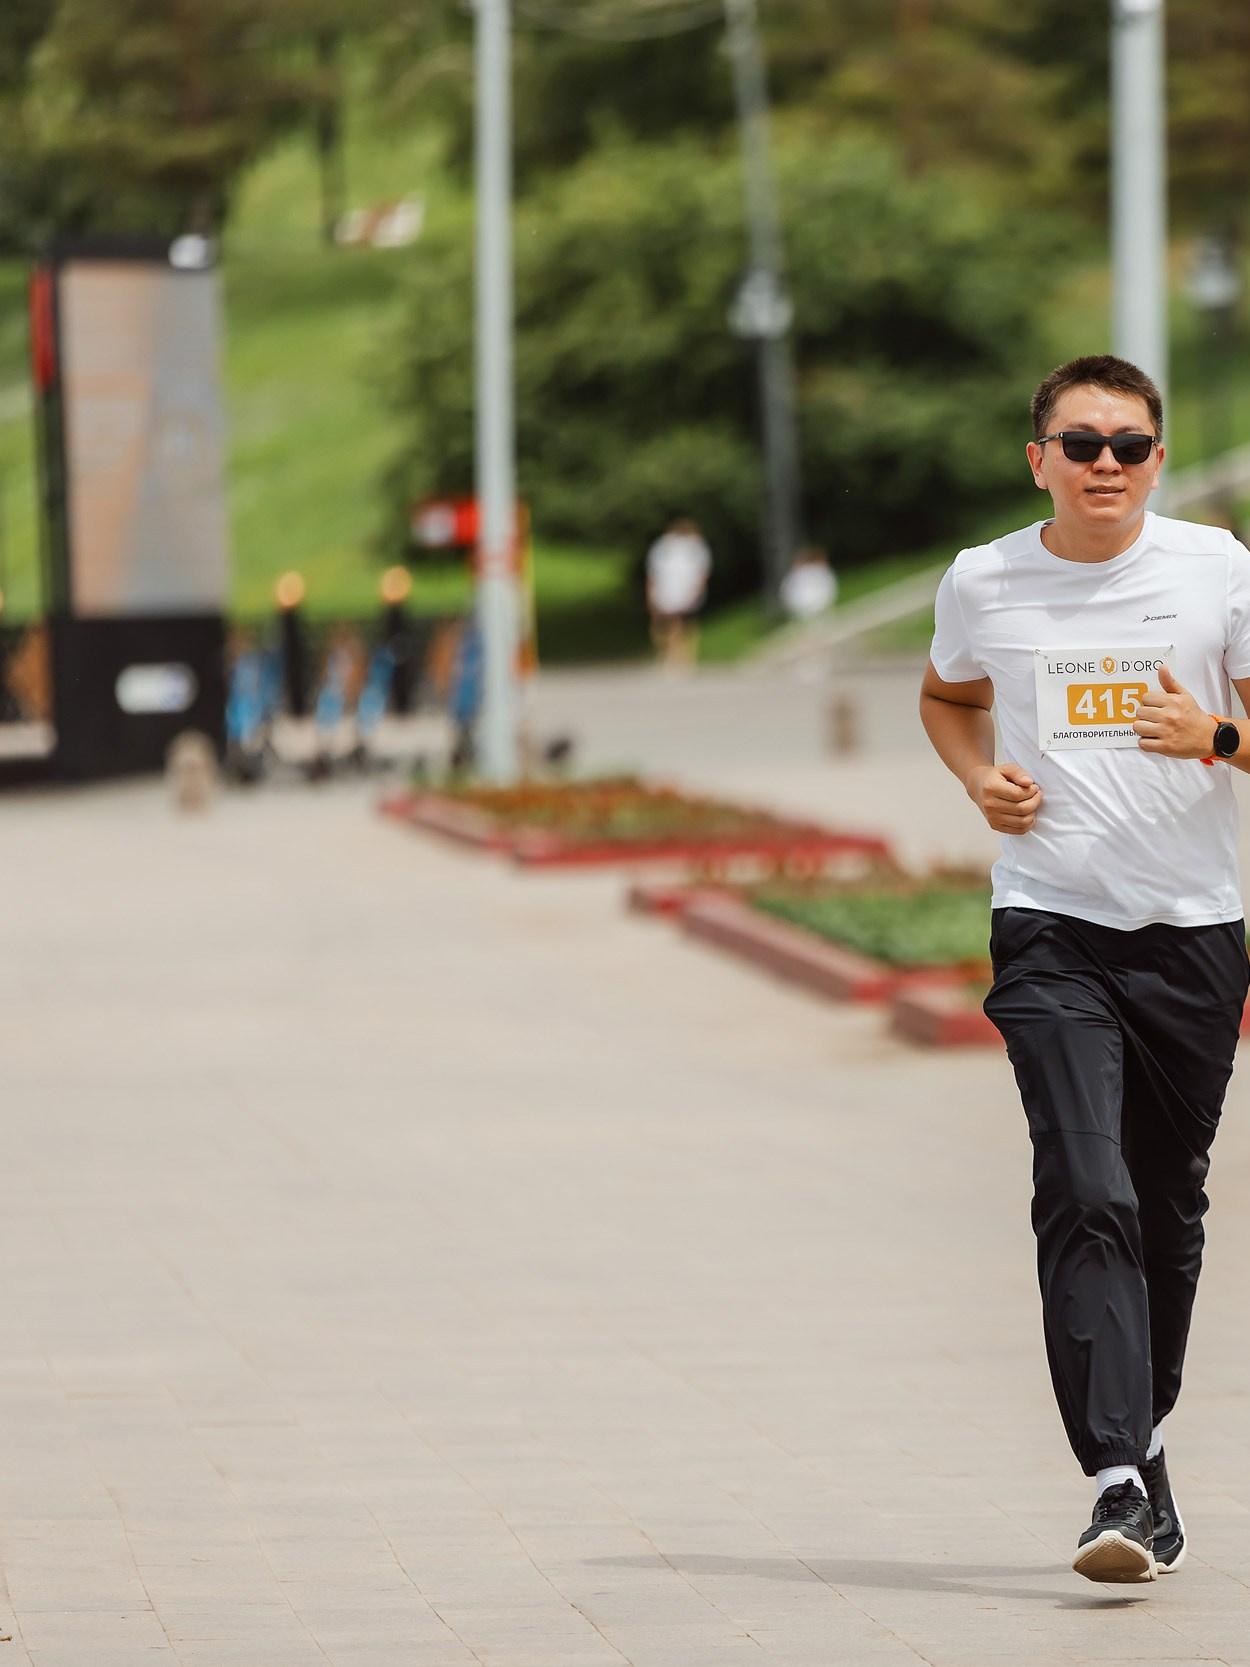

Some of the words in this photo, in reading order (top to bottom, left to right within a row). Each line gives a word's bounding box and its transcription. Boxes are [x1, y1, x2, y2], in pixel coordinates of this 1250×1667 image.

[1048, 661, 1096, 674] LEONE
[1121, 659, 1164, 672] D'ORO
[1075, 688, 1141, 719] 415
[1053, 729, 1139, 739] БЛАГОТВОРИТЕЛЬНЫ
